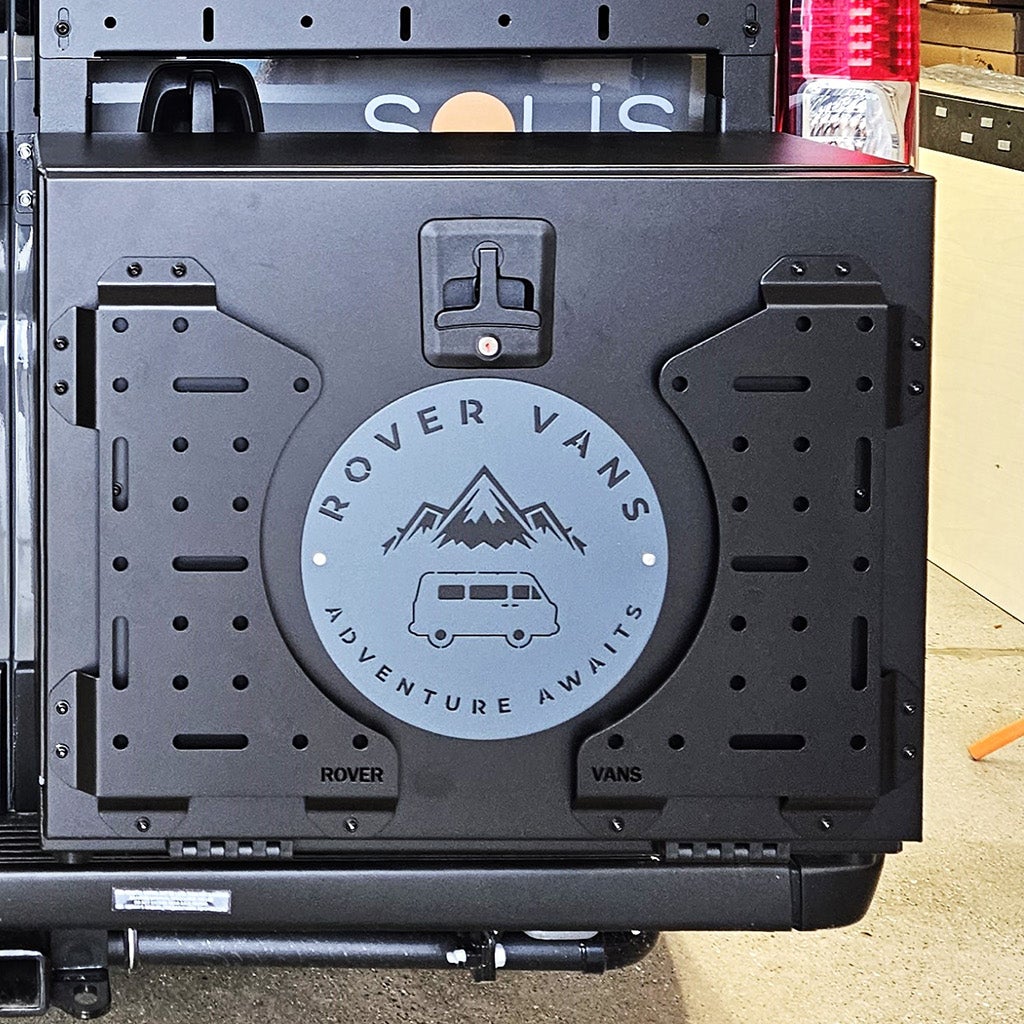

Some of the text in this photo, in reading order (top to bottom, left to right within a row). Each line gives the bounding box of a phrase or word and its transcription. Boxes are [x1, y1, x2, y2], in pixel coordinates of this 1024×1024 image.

[318, 399, 650, 522] ROVER VANS
[325, 604, 642, 714] ADVENTURE AWAITS
[320, 766, 384, 783] ROVER
[590, 766, 643, 783] VANS
